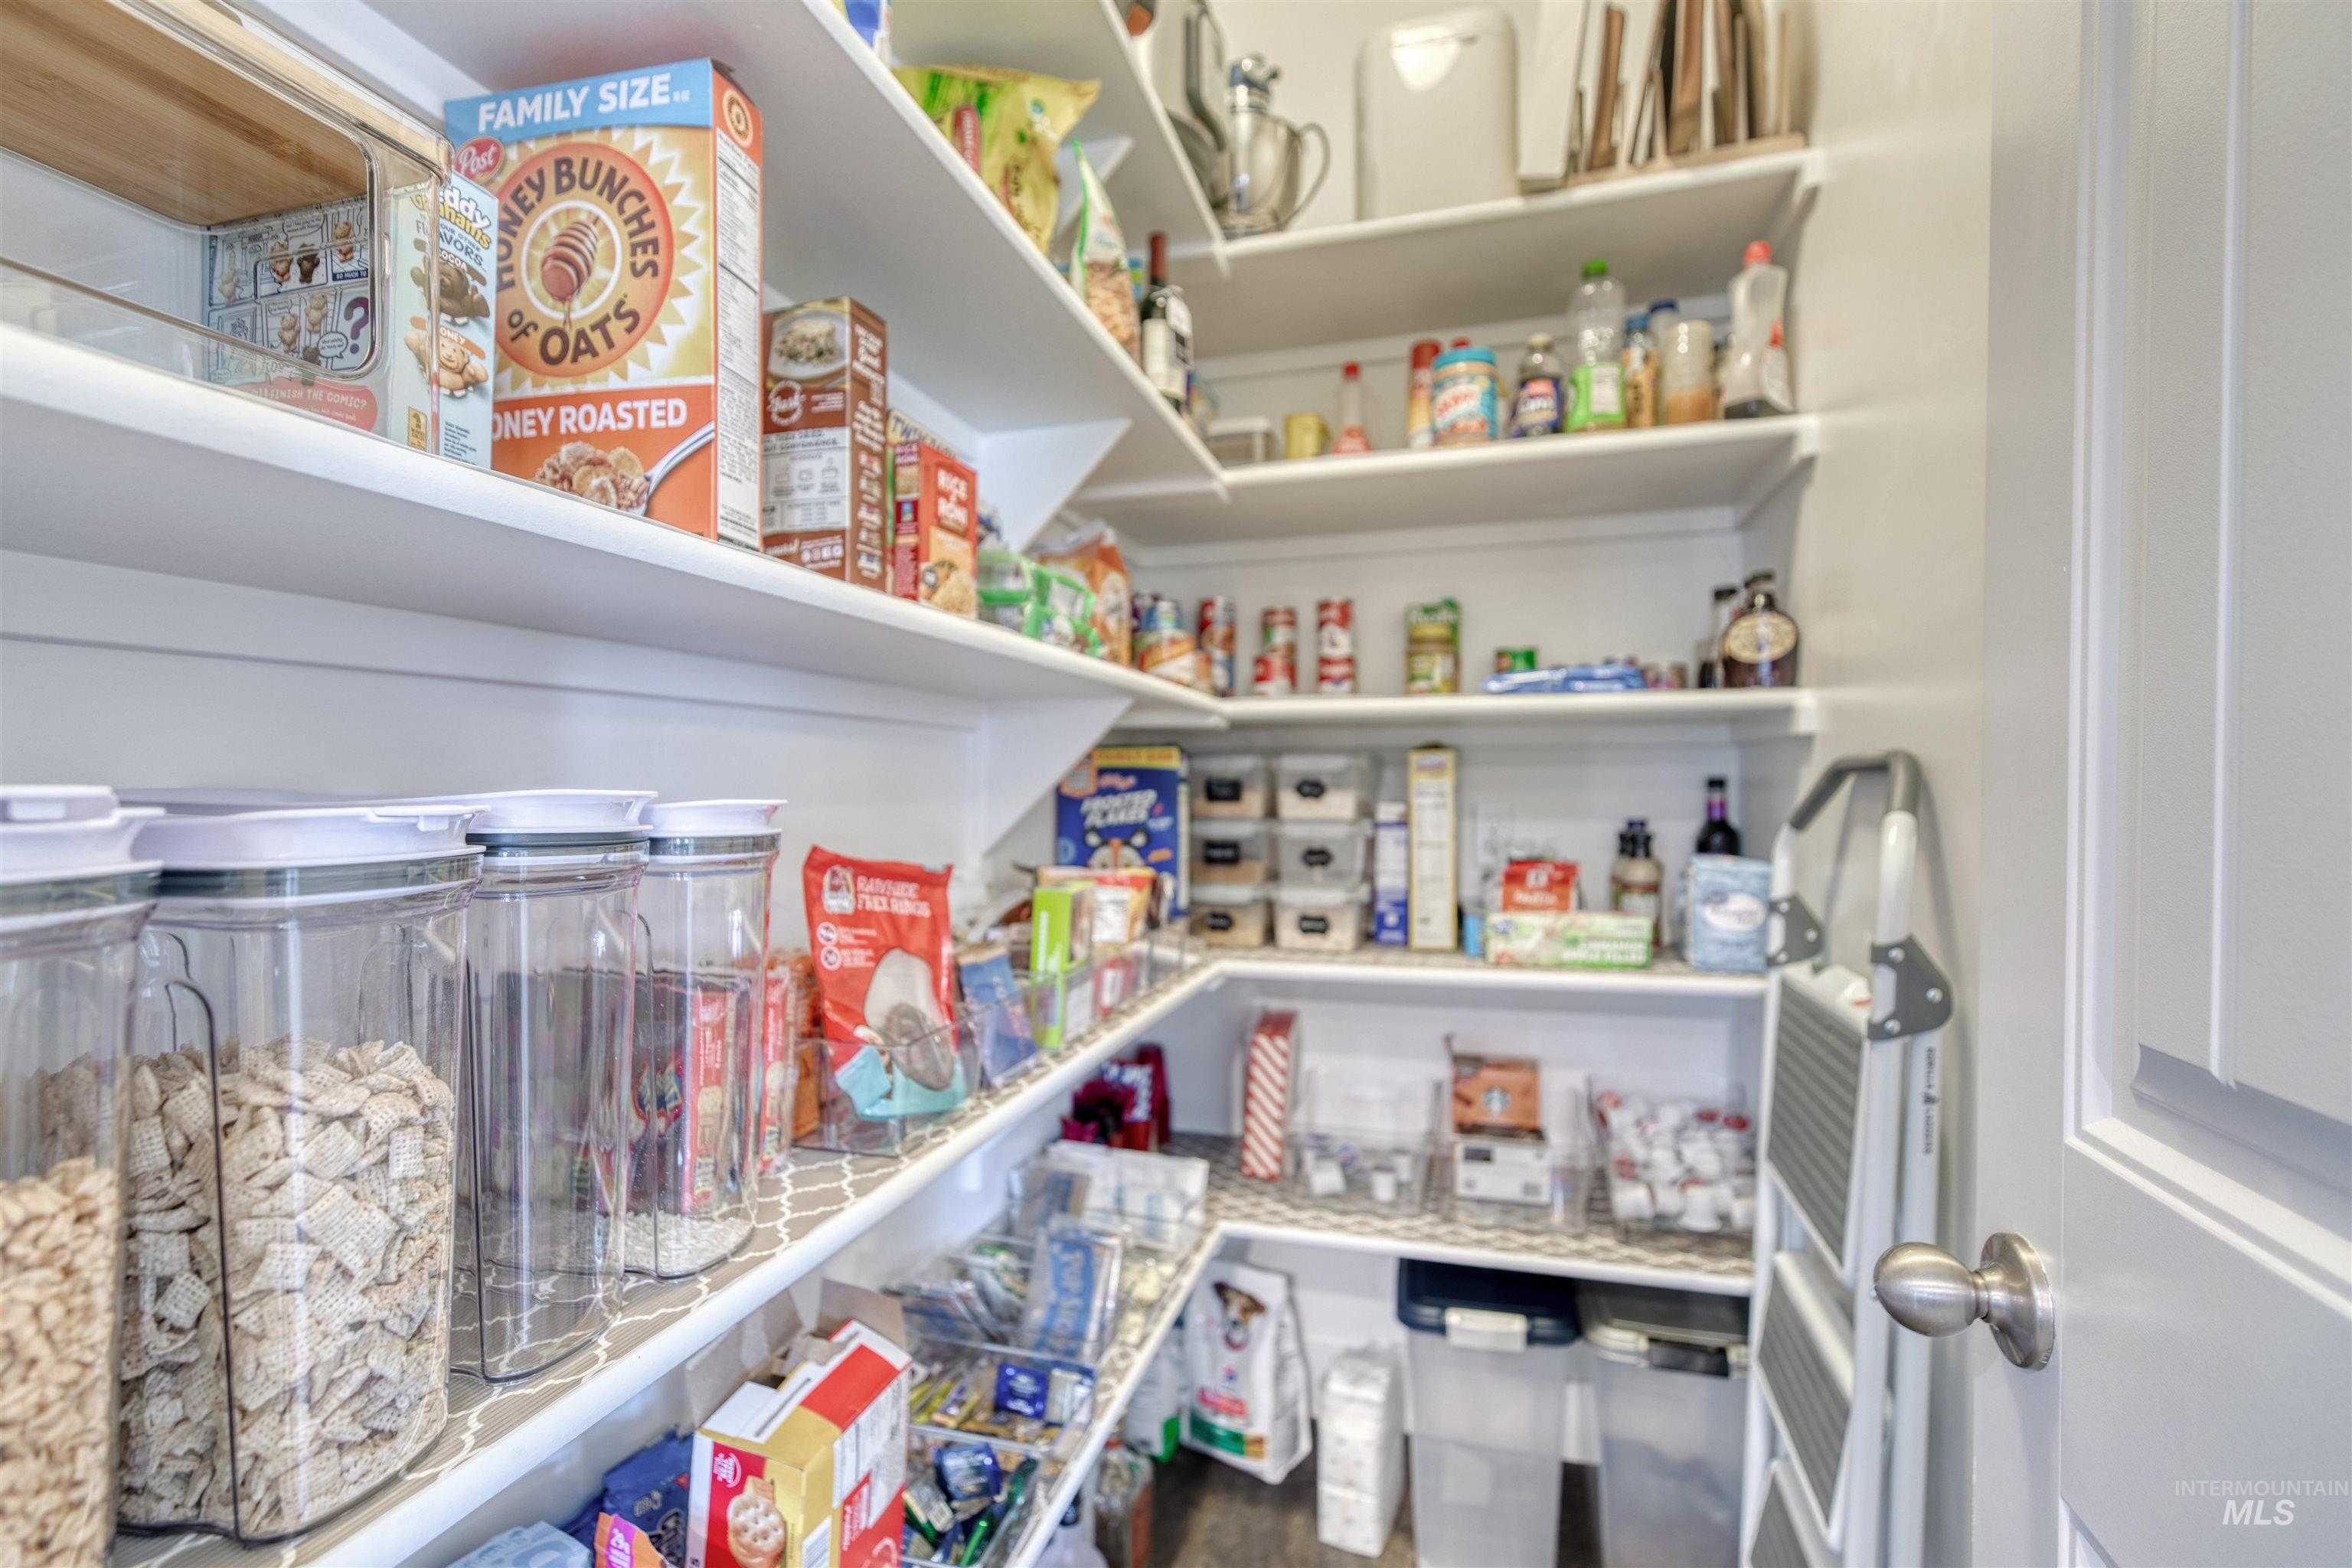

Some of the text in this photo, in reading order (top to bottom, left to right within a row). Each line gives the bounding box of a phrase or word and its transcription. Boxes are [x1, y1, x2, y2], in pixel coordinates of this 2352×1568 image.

[478, 86, 589, 133] FAMILY
[597, 73, 671, 114] SIZE
[460, 142, 498, 175] Post
[410, 194, 492, 250] Grhams
[496, 167, 545, 292] HONEY
[554, 157, 660, 279] BUNCHES
[440, 326, 466, 345] ONEY
[507, 297, 641, 366] of OATS
[270, 388, 303, 400] FINISH
[307, 388, 324, 401] THE
[327, 390, 367, 411] COMIC?
[492, 397, 688, 442] ONEY ROASTED
